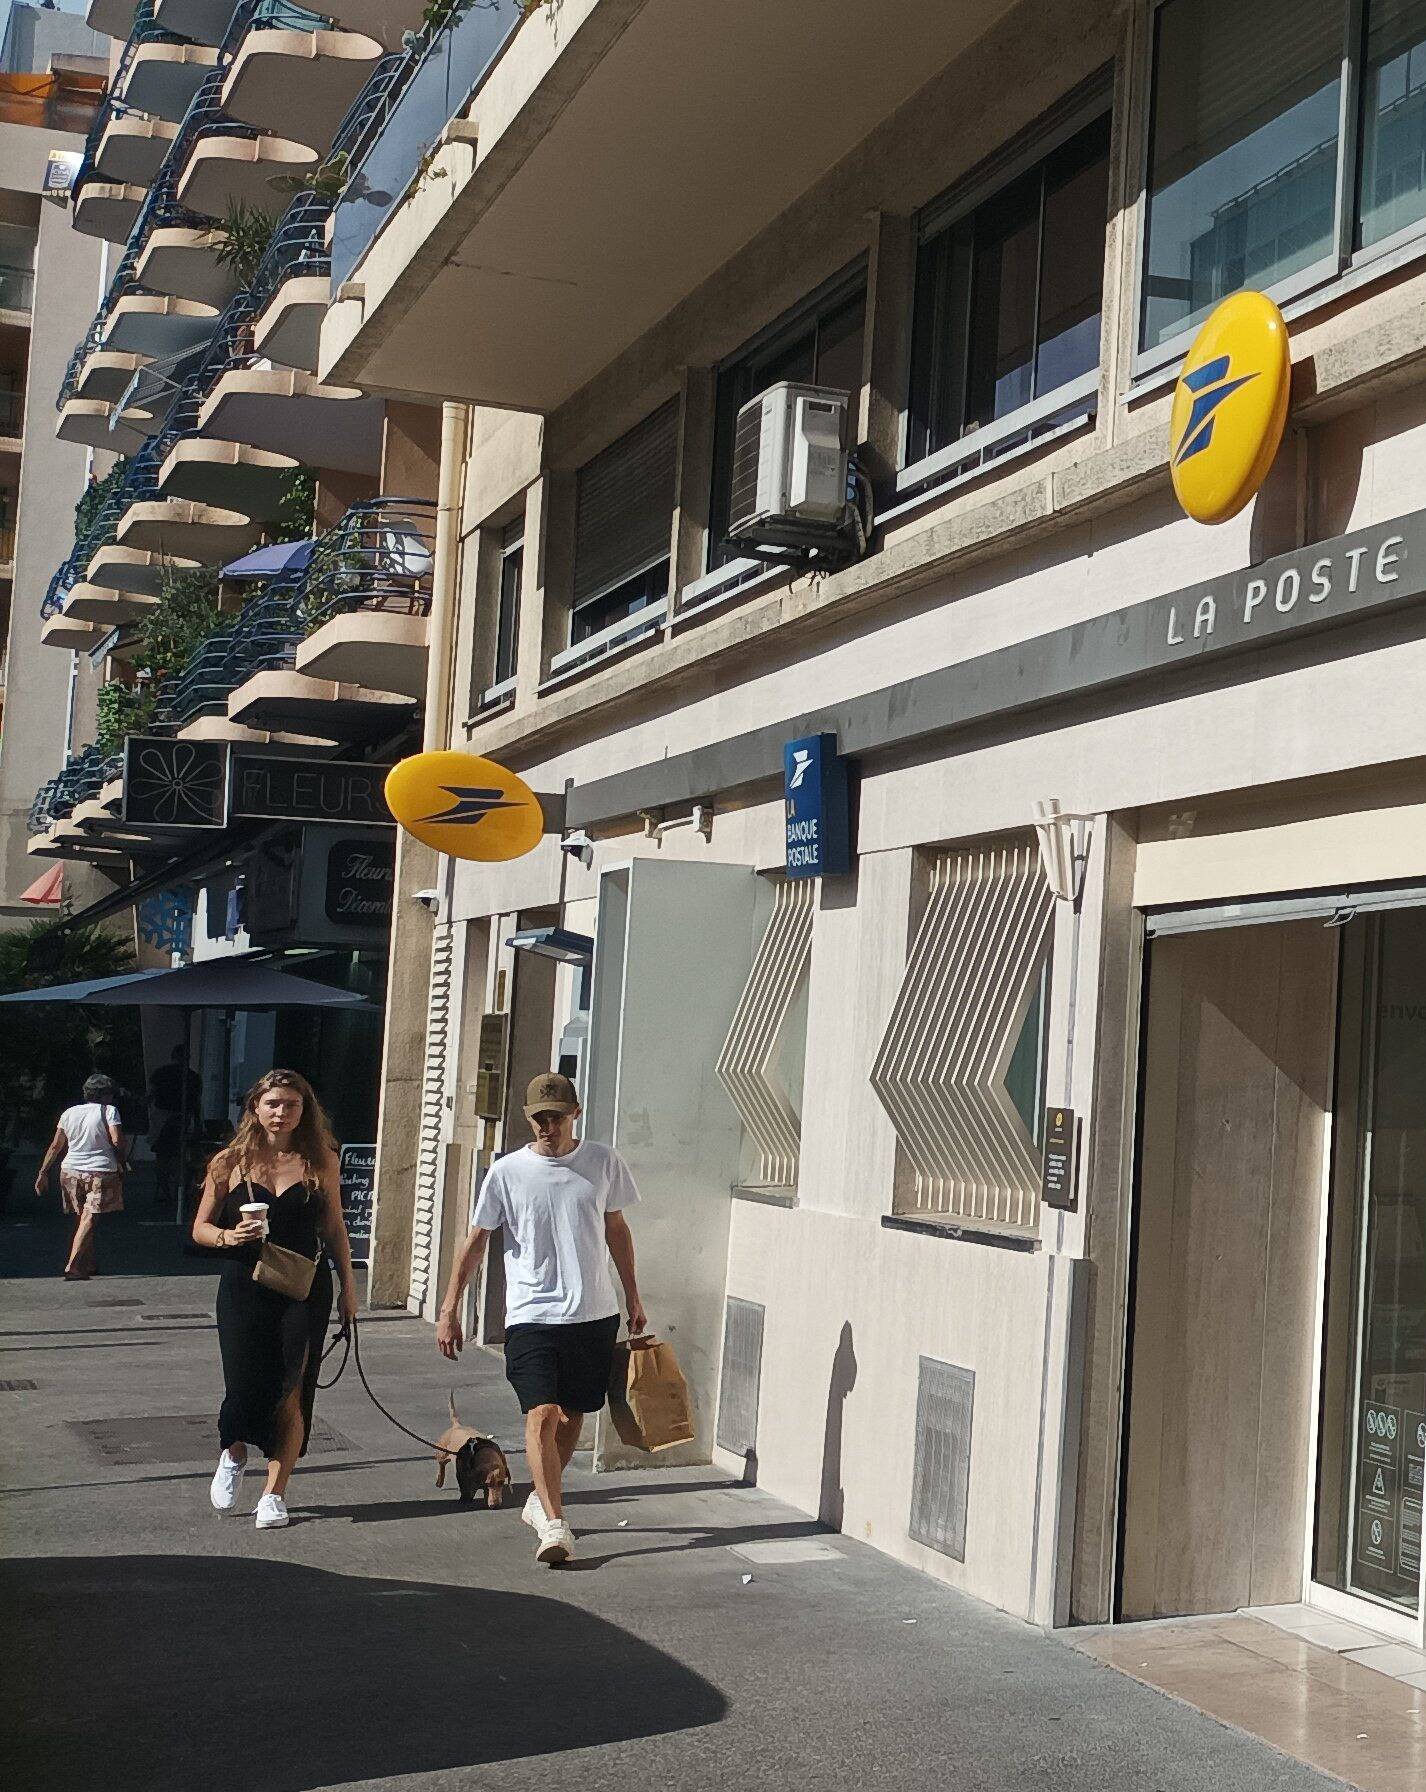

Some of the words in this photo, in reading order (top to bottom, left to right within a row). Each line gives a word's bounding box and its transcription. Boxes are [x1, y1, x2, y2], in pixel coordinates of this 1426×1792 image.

[1166, 594, 1217, 646] LA
[1242, 534, 1404, 624] POSTE
[787, 799, 796, 818] LA
[787, 819, 818, 842] BANQUE
[788, 844, 818, 867] POSTALE
